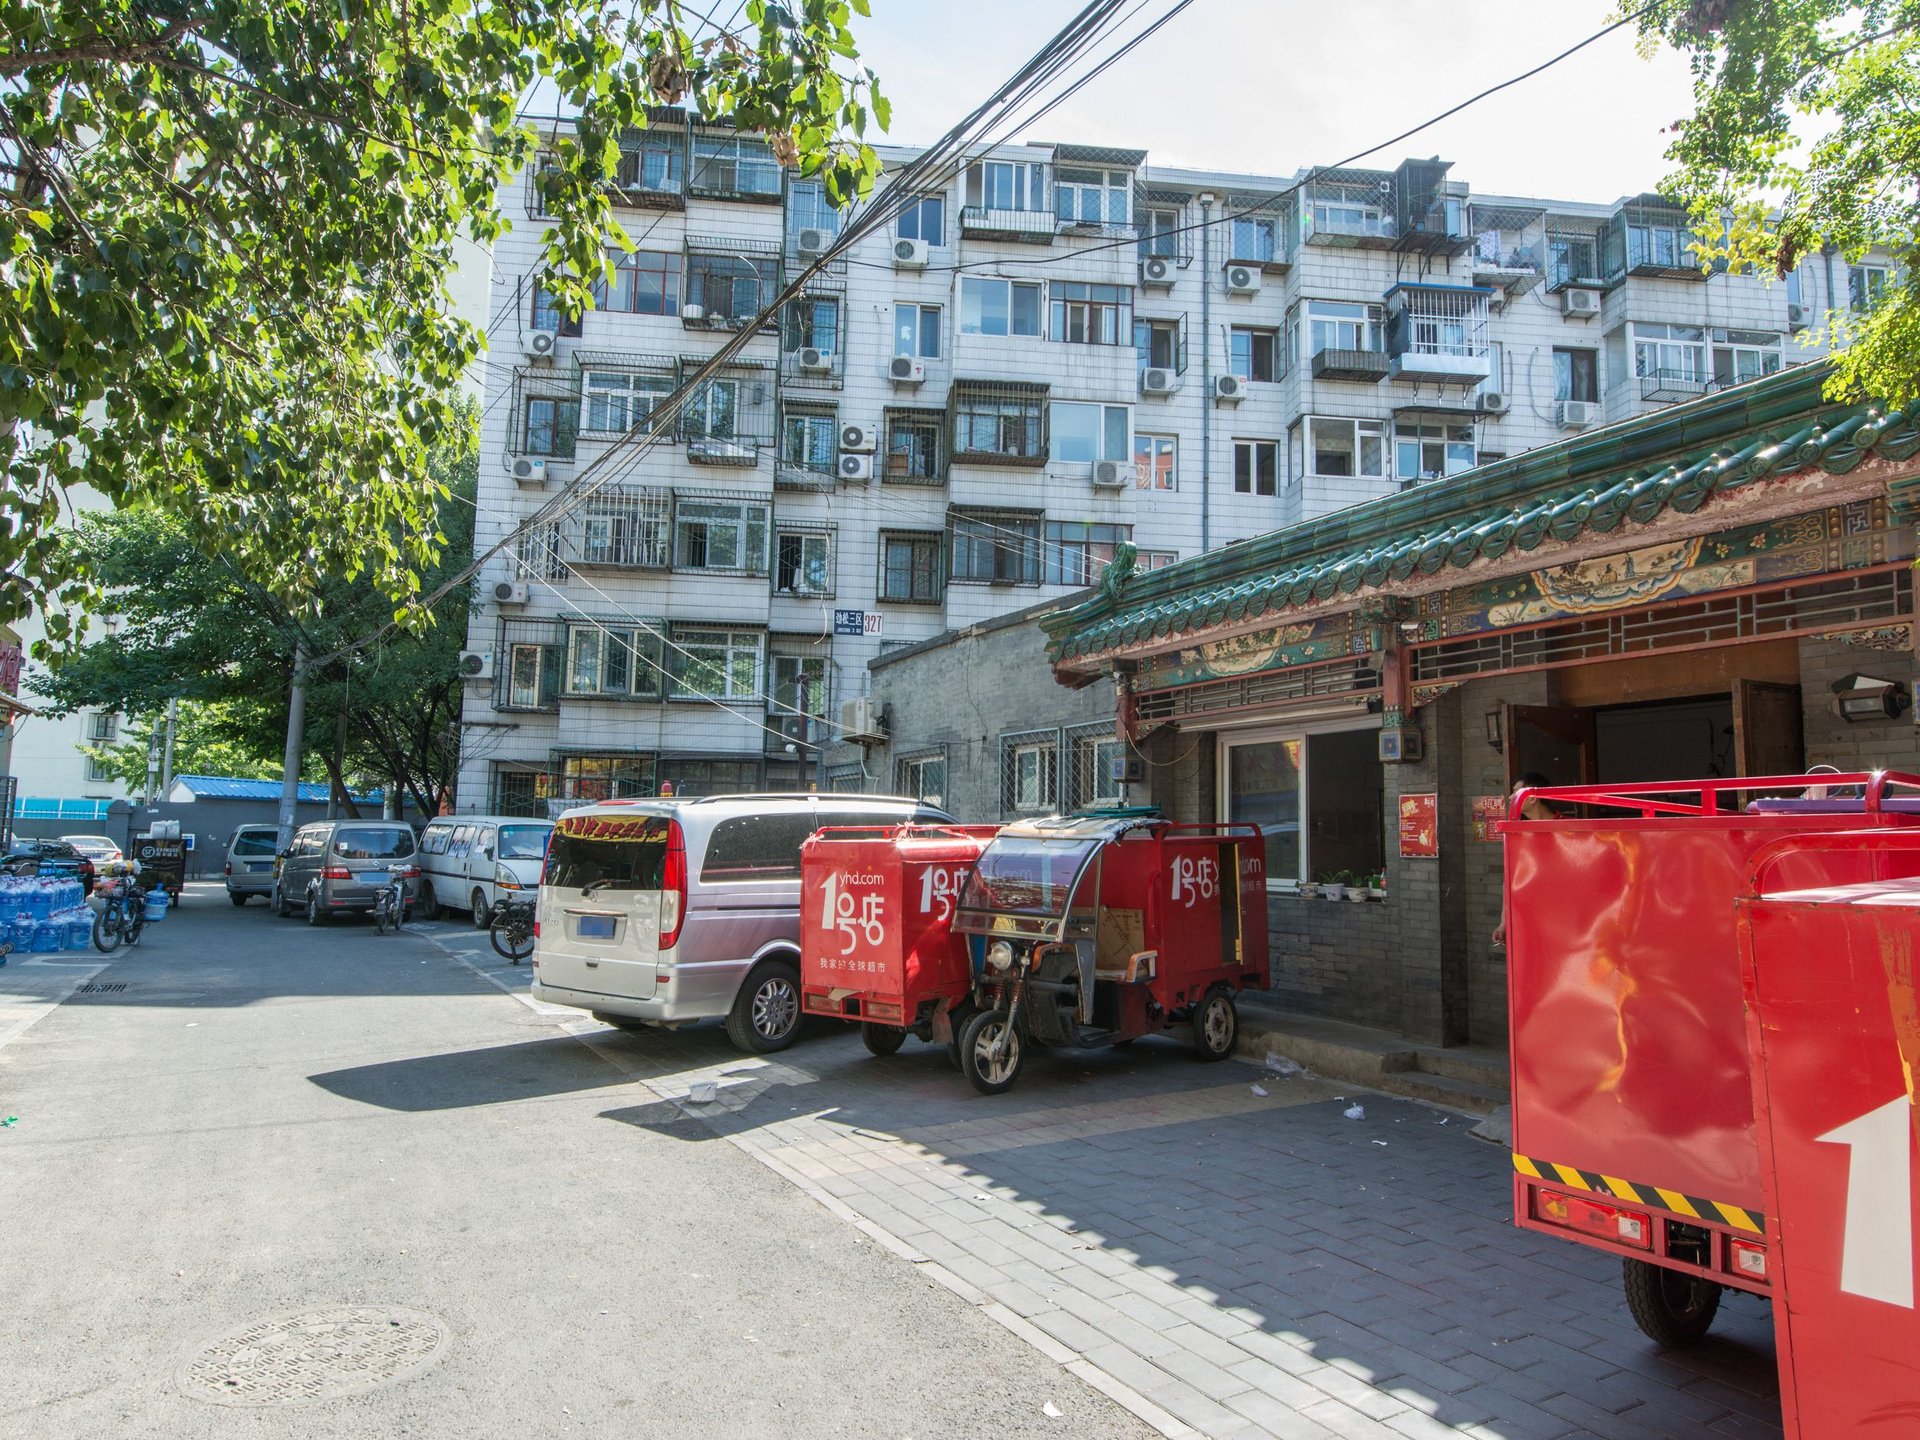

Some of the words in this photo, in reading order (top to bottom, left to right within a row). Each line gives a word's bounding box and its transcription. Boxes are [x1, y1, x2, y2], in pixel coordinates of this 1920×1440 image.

[836, 612, 862, 625] 劲松三区
[865, 615, 882, 633] 327
[839, 870, 885, 887] yhd.com
[1170, 854, 1213, 908] 1号店
